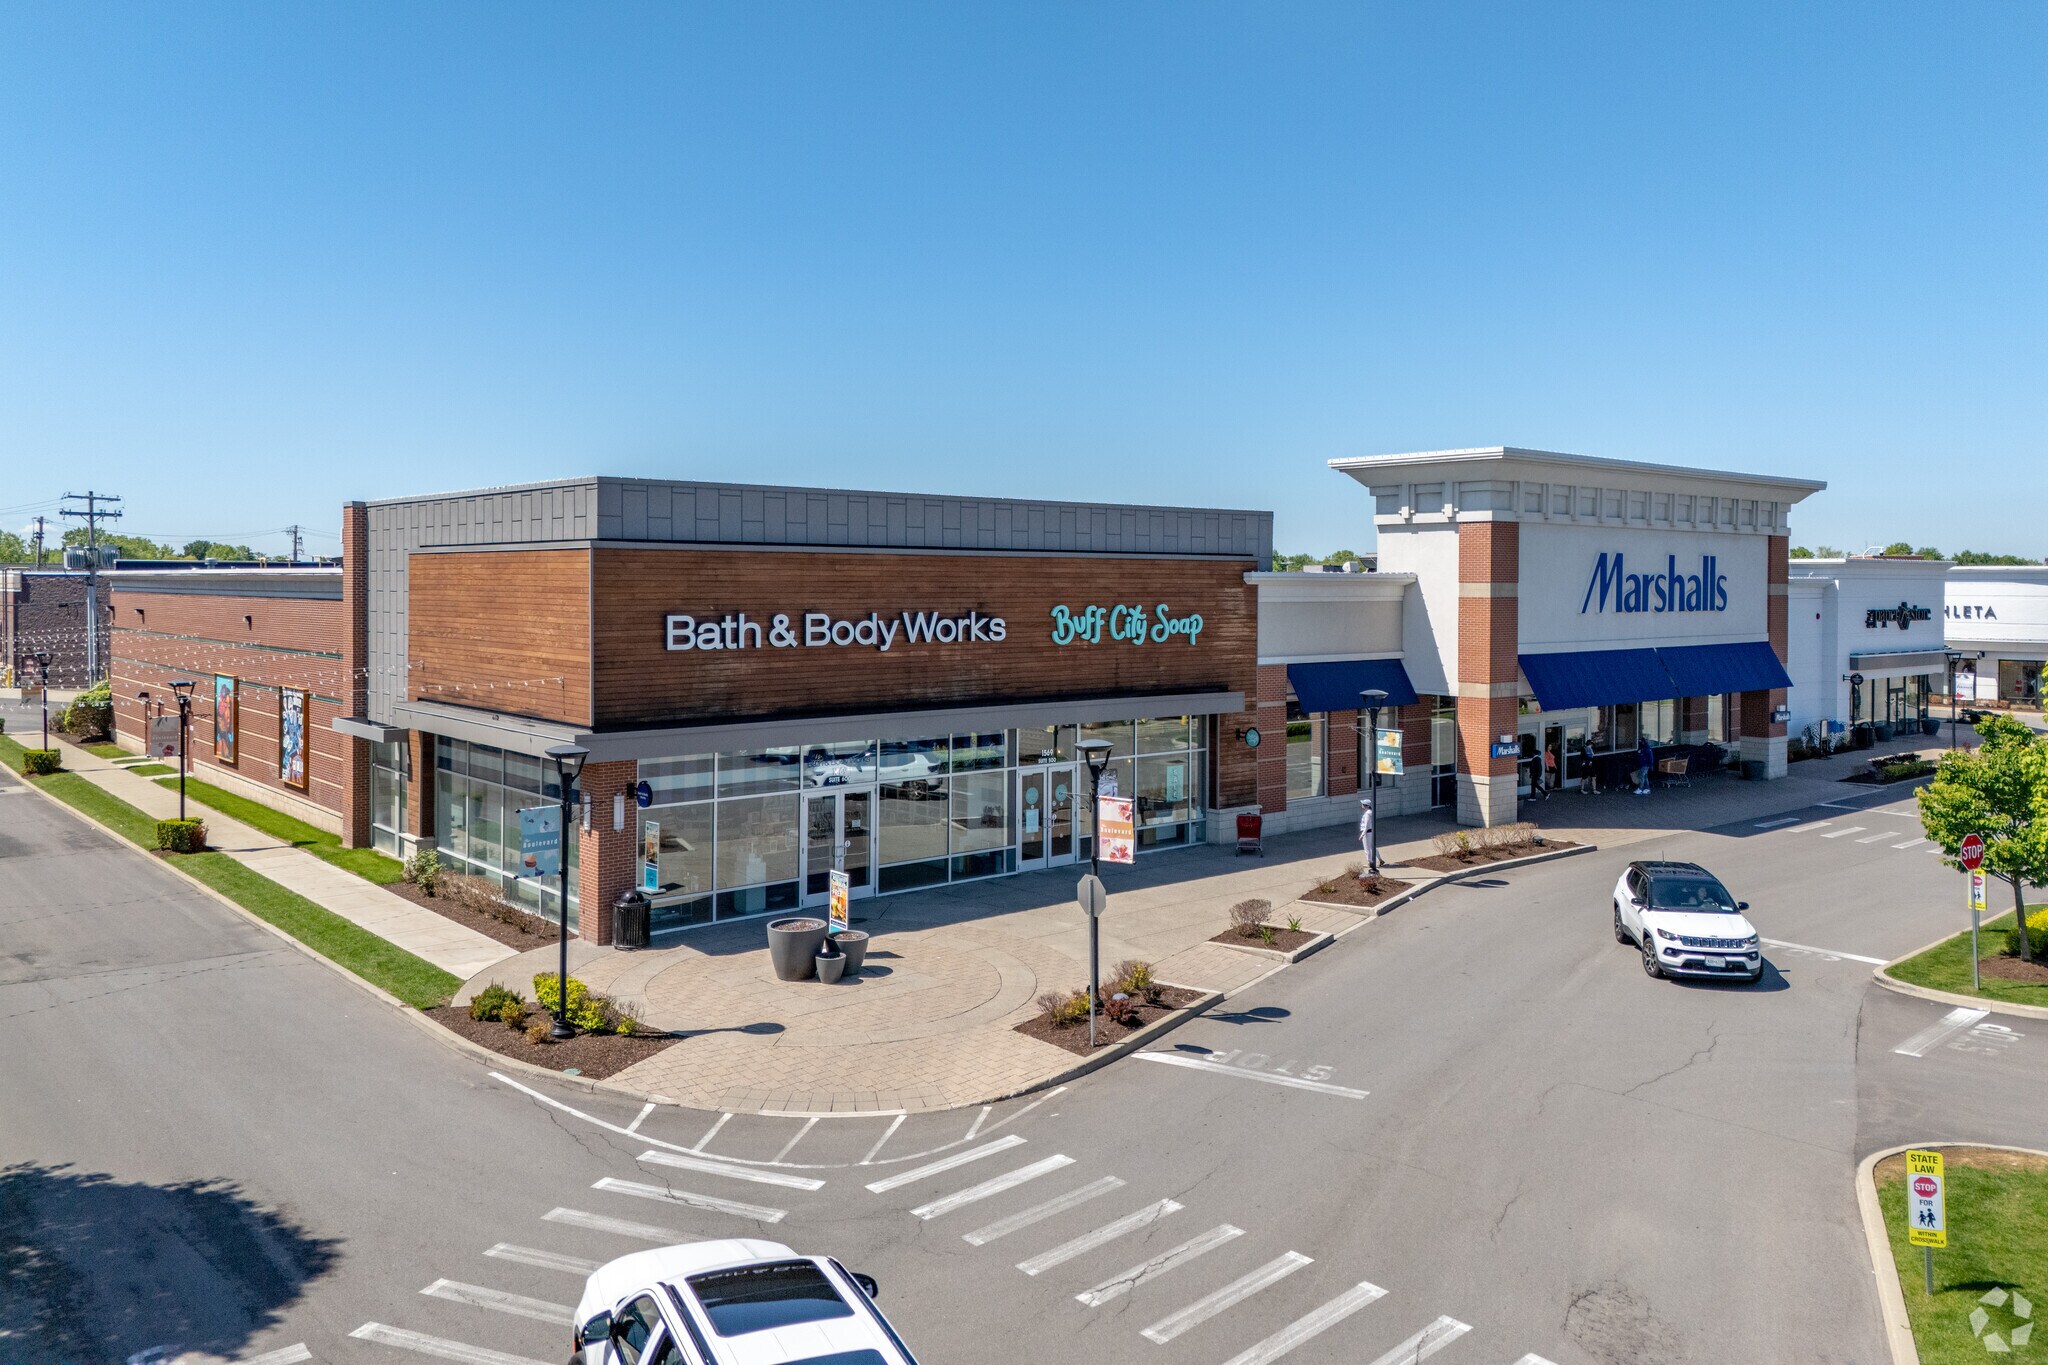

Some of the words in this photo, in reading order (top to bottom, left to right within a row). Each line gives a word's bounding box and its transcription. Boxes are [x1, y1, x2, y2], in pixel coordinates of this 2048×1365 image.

[1581, 552, 1728, 614] Marshalls
[1050, 604, 1107, 646] Buff
[1109, 604, 1147, 646] City
[1150, 603, 1204, 646] Soap
[666, 613, 762, 651] Bath
[768, 613, 799, 648] &
[804, 612, 900, 651] Body
[902, 611, 1006, 644] Works
[522, 838, 559, 849] Boulevard
[1962, 845, 1983, 860] STOP
[1203, 1049, 1338, 1081] STOP
[1910, 1153, 1939, 1164] STATE
[1914, 1164, 1935, 1174] LAW
[1914, 1182, 1937, 1192] STOP
[1919, 1199, 1934, 1207] FOR
[1917, 1230, 1938, 1238] WITHIN
[1910, 1236, 1945, 1245] CROSSWALK
